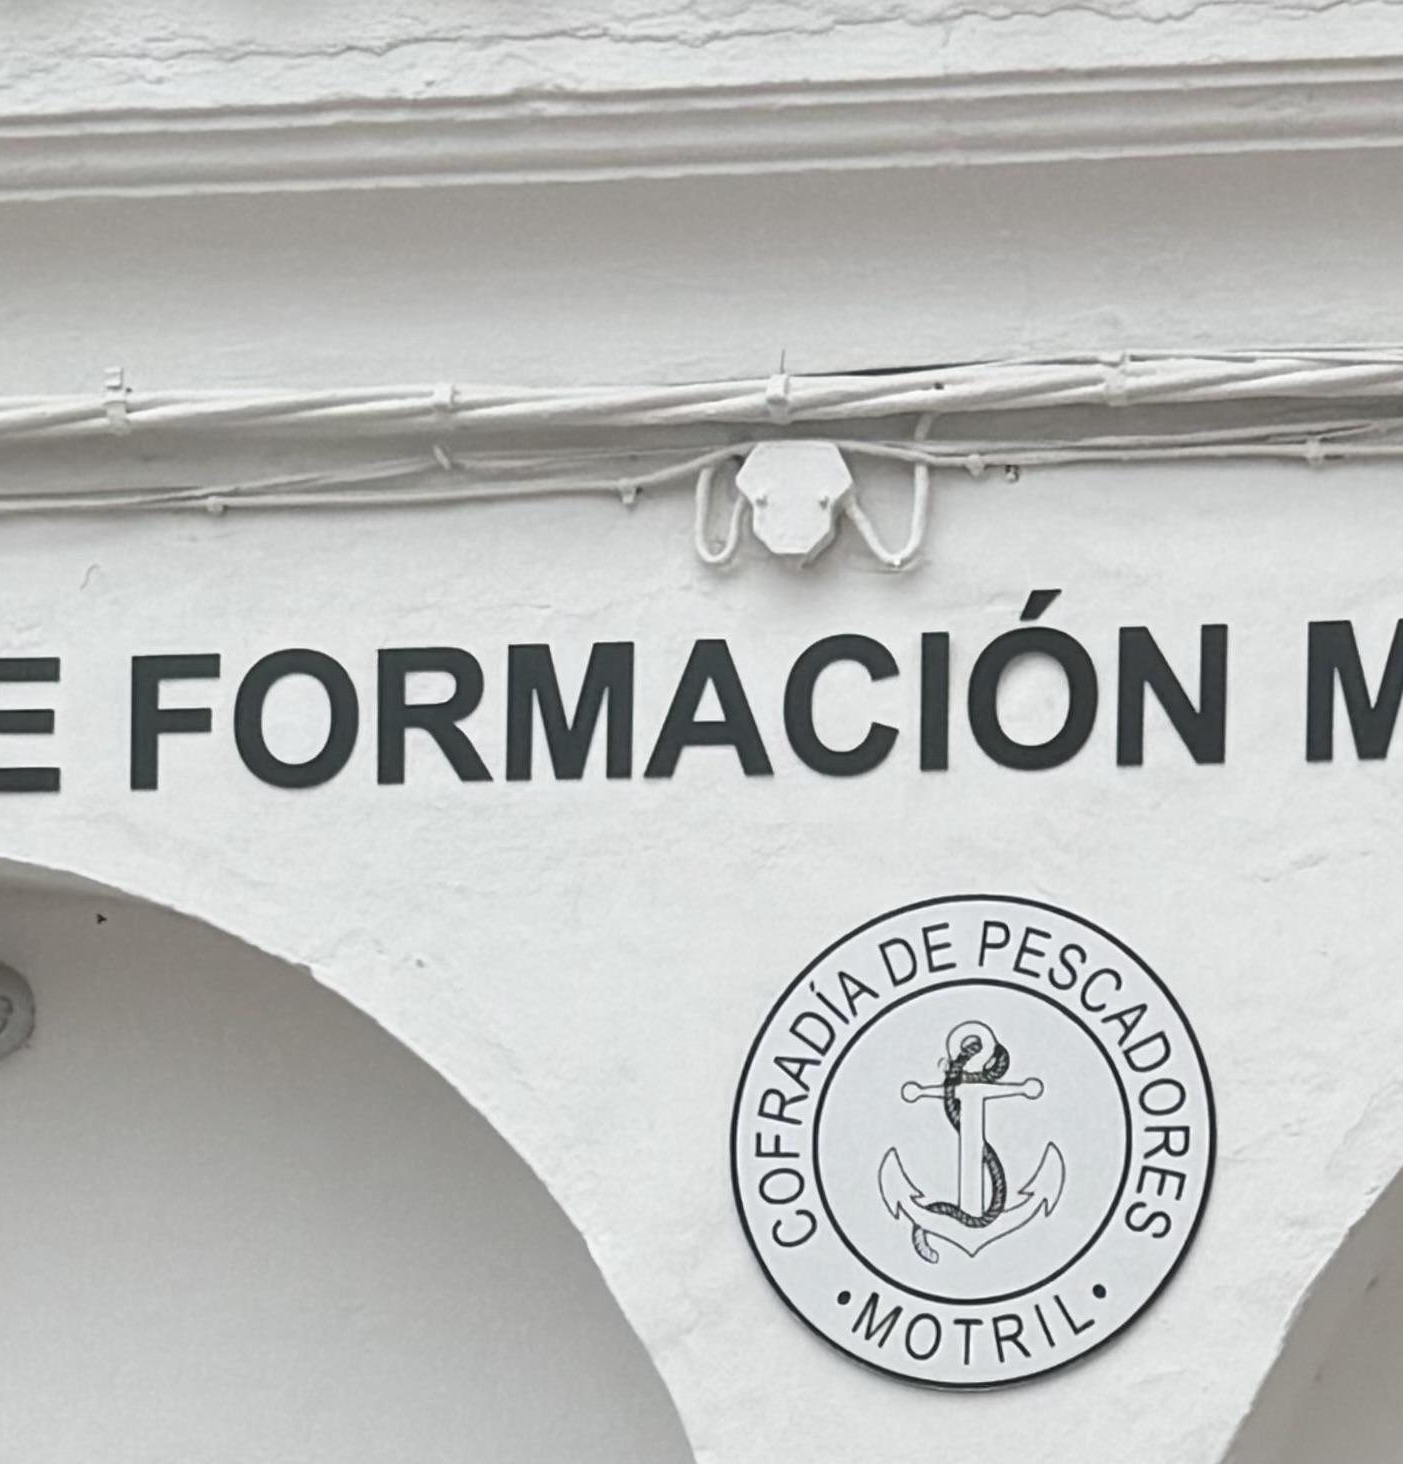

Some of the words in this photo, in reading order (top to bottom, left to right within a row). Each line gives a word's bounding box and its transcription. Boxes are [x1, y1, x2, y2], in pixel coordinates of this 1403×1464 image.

[130, 589, 1228, 791] FORMACIÓN
[755, 971, 880, 1249] COFRADÍA
[877, 922, 957, 988] DE
[978, 920, 1191, 1240] PESCADORES
[851, 1291, 1096, 1366] MOTRIL
